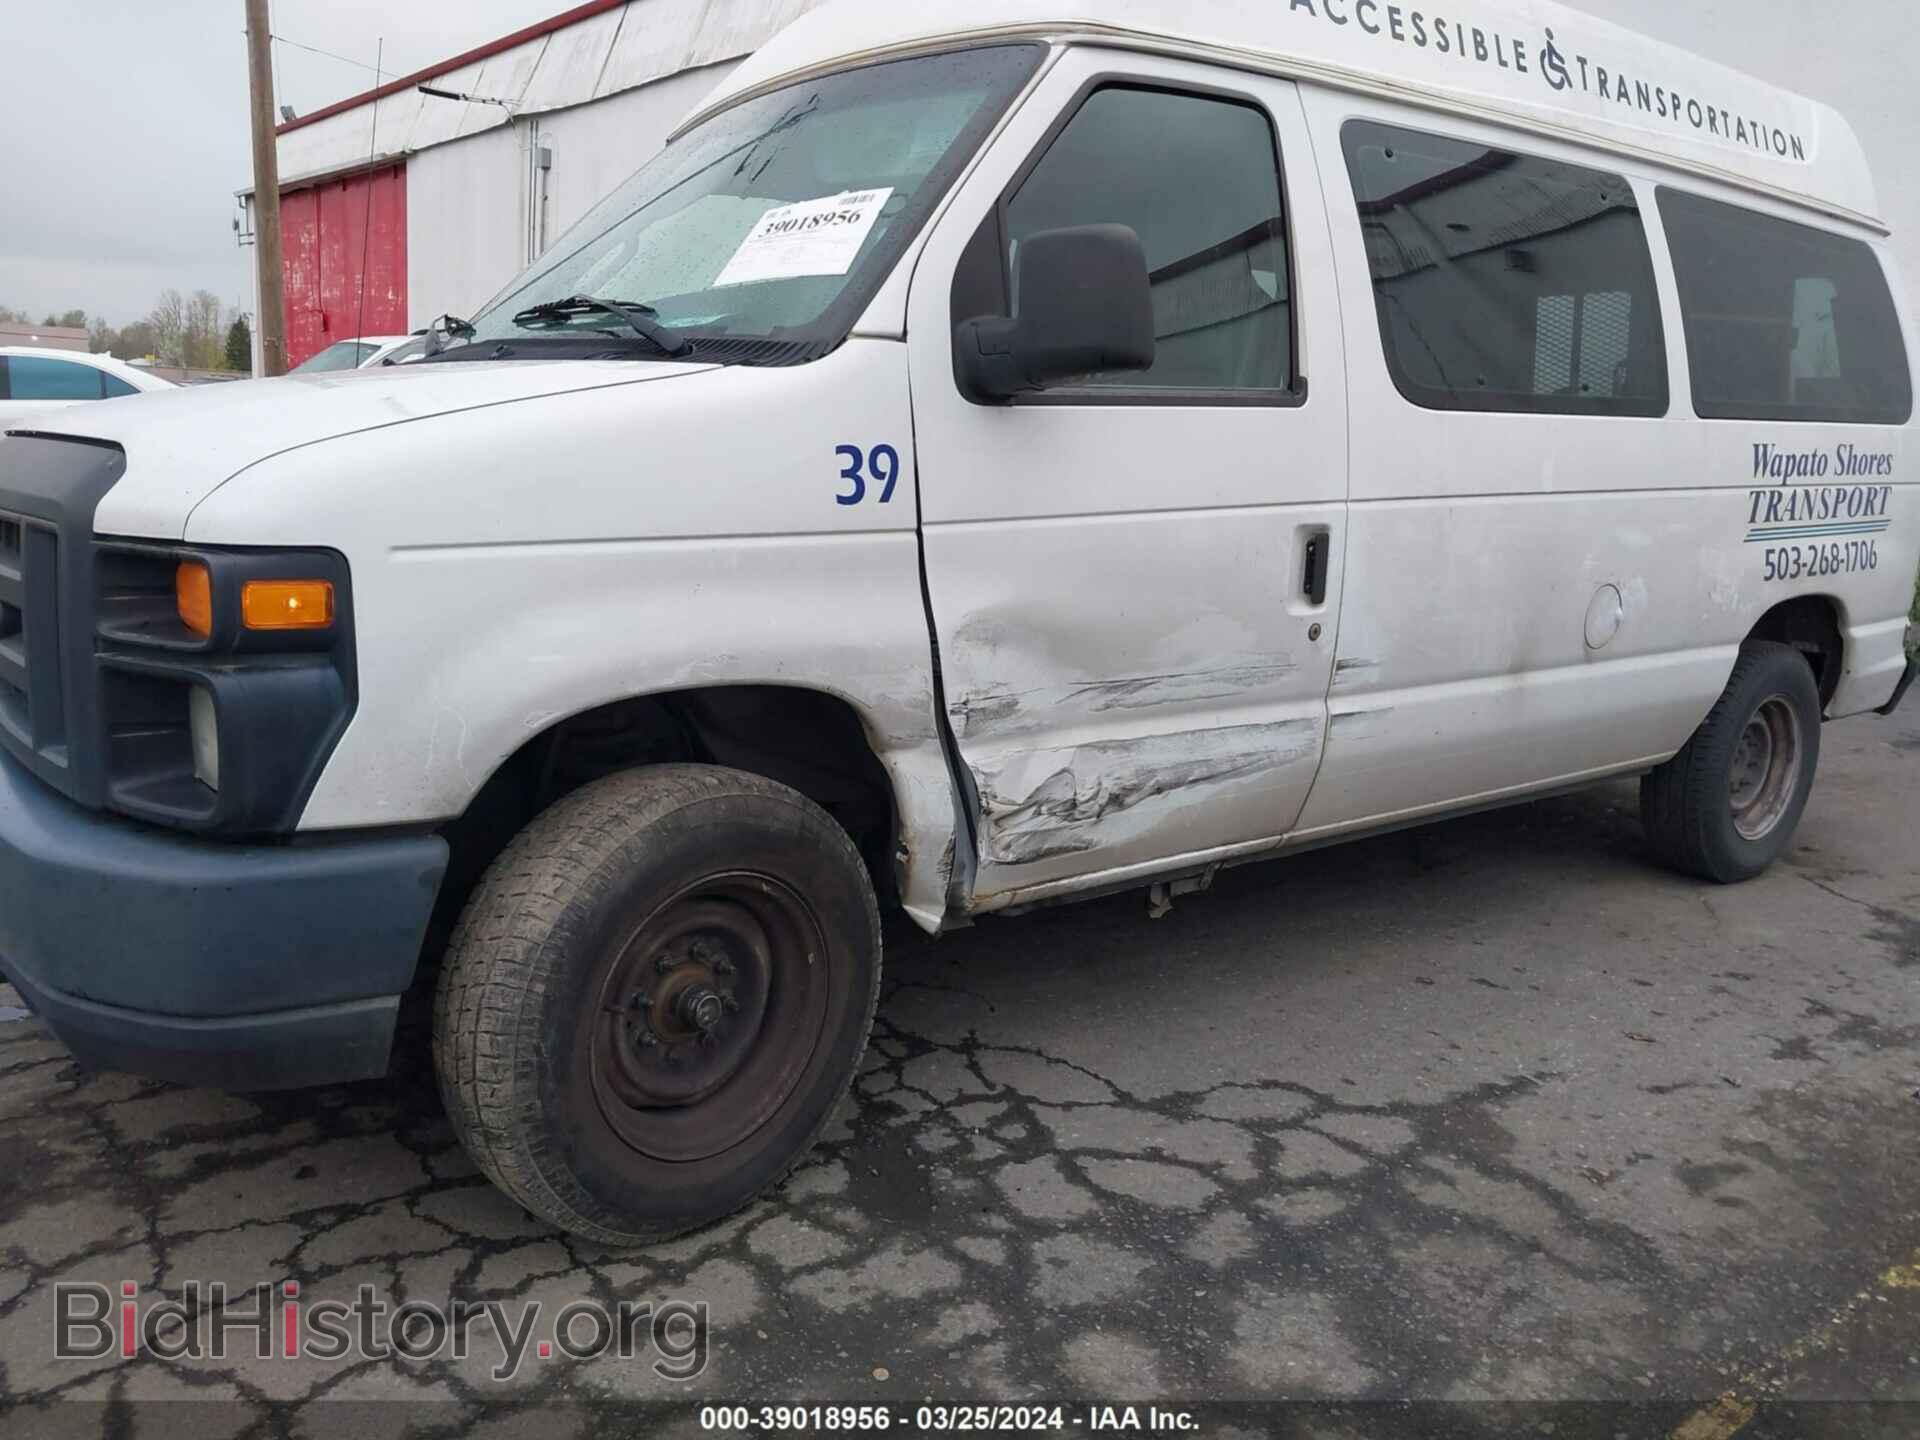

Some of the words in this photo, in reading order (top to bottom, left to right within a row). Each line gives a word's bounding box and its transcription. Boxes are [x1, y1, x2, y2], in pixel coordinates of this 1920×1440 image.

[1576, 54, 1806, 162] TRANSPORTATION
[757, 207, 864, 238] 39018956
[835, 443, 900, 506] 39
[1752, 443, 1829, 486] Wapato
[1834, 443, 1895, 477] Shores
[1747, 486, 1892, 524] TRANSPORT
[1763, 540, 1878, 582] 503-268-1706
